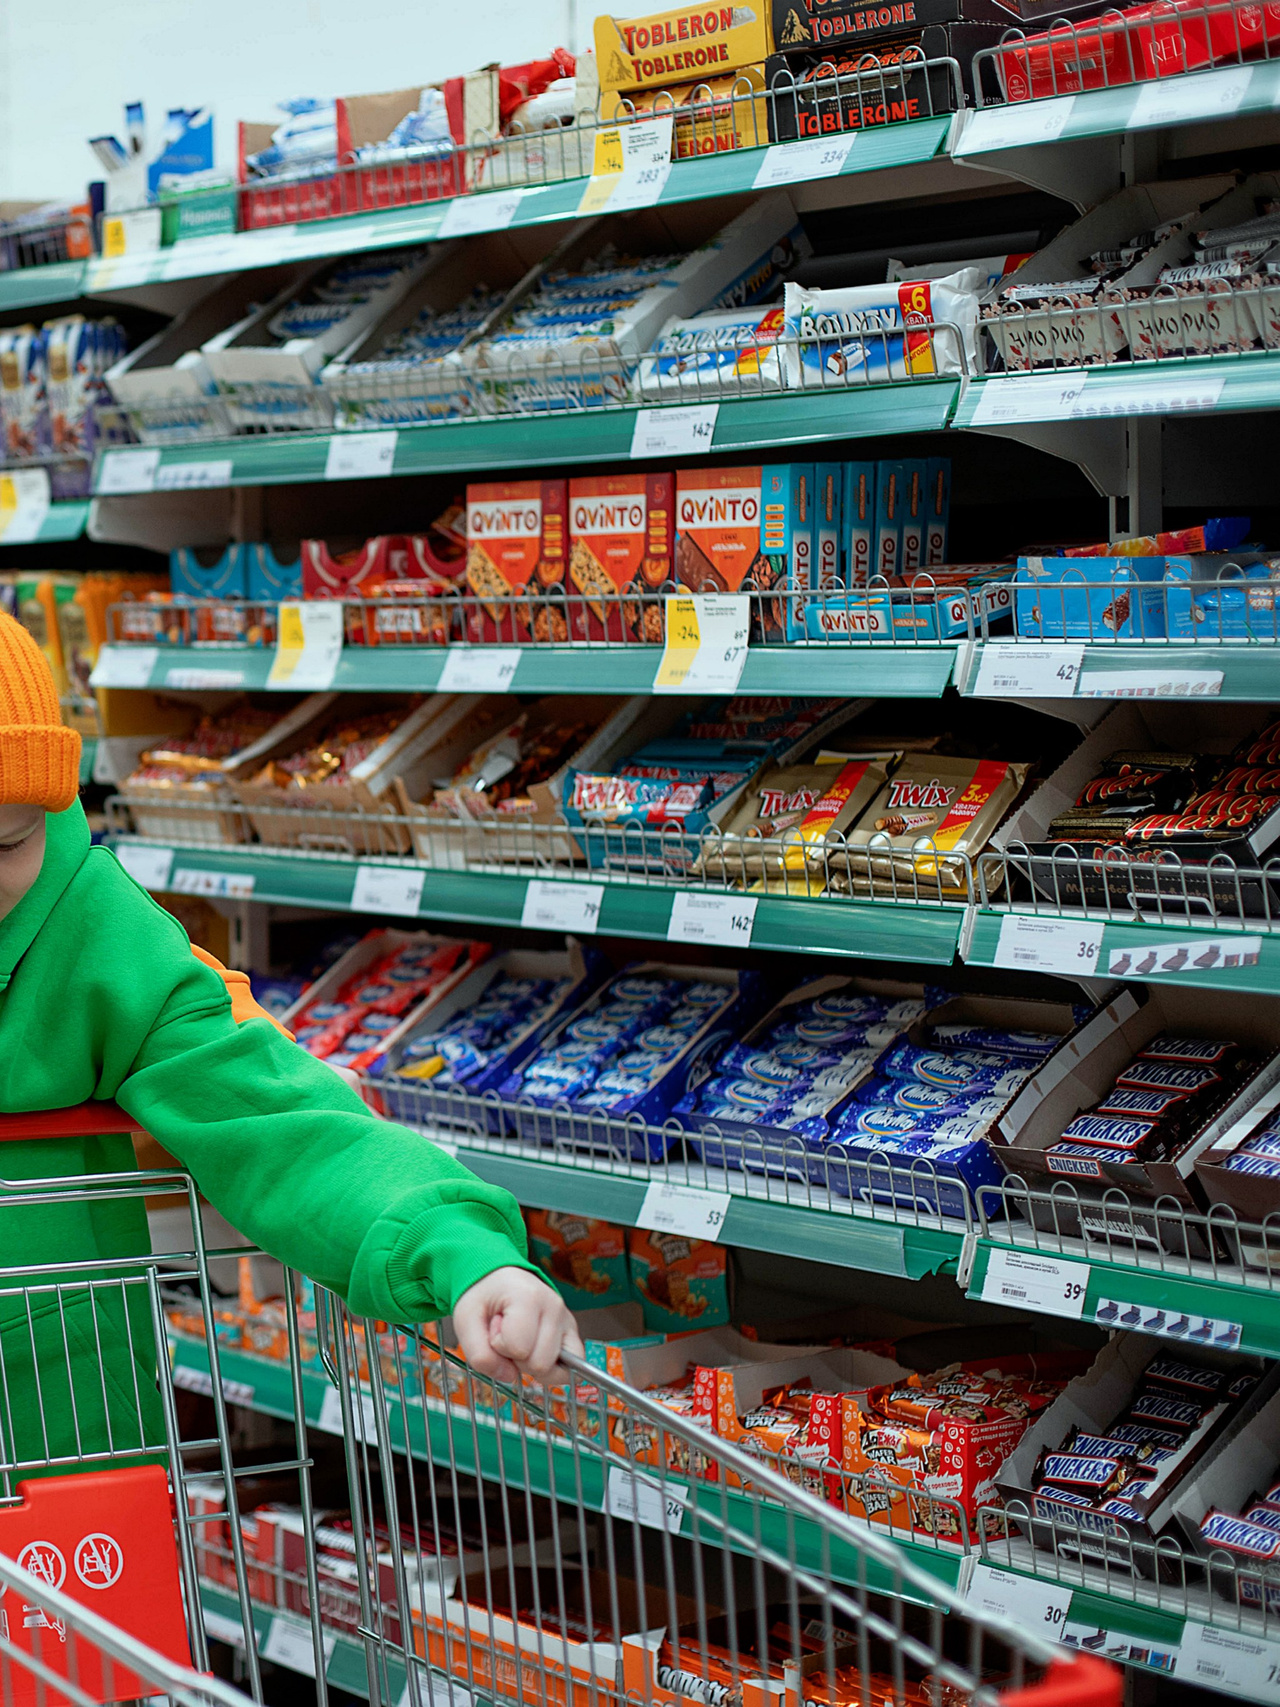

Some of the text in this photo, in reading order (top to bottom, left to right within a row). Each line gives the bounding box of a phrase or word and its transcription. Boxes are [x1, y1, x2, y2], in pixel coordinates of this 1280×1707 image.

[623, 7, 733, 55] TOBLERON
[809, 2, 916, 42] TOBLERONE
[1148, 33, 1186, 65] RED
[631, 43, 729, 81] TOBLERONE
[795, 98, 920, 135] TOBLERONE
[677, 131, 744, 160] ERONE
[1170, 262, 1230, 282] ЧИО РИО
[802, 308, 897, 338] BOUNTY
[1138, 312, 1220, 337] ЧИО РИО
[1010, 326, 1084, 348] ЧИО РИО
[724, 647, 740, 662] 67
[1056, 664, 1075, 680] 42
[888, 778, 955, 809] Twix
[961, 783, 990, 804] 3x2
[1182, 788, 1280, 817] Mar
[1125, 814, 1253, 840] Mars
[731, 915, 749, 931] 142
[1077, 941, 1095, 958] 36
[1006, 1074, 1023, 1091] 1+
[1123, 1063, 1214, 1088] SNICKERS
[980, 1101, 1004, 1115] 1+
[946, 1120, 979, 1139] 1+1
[1066, 1116, 1151, 1144] SNICKERS
[1049, 1156, 1099, 1175] SNICKERS
[706, 1210, 721, 1226] 53
[1063, 1282, 1081, 1300] 39
[1133, 1395, 1201, 1424] SNICKER
[1073, 1436, 1136, 1459] SNICKER
[1045, 1456, 1116, 1482] SNICKERS
[666, 1502, 680, 1517] 24
[867, 1502, 890, 1514] BAR
[1036, 1500, 1116, 1537] SNICKERS
[1201, 1515, 1276, 1553] SNICKERS
[1044, 1606, 1061, 1624] 30
